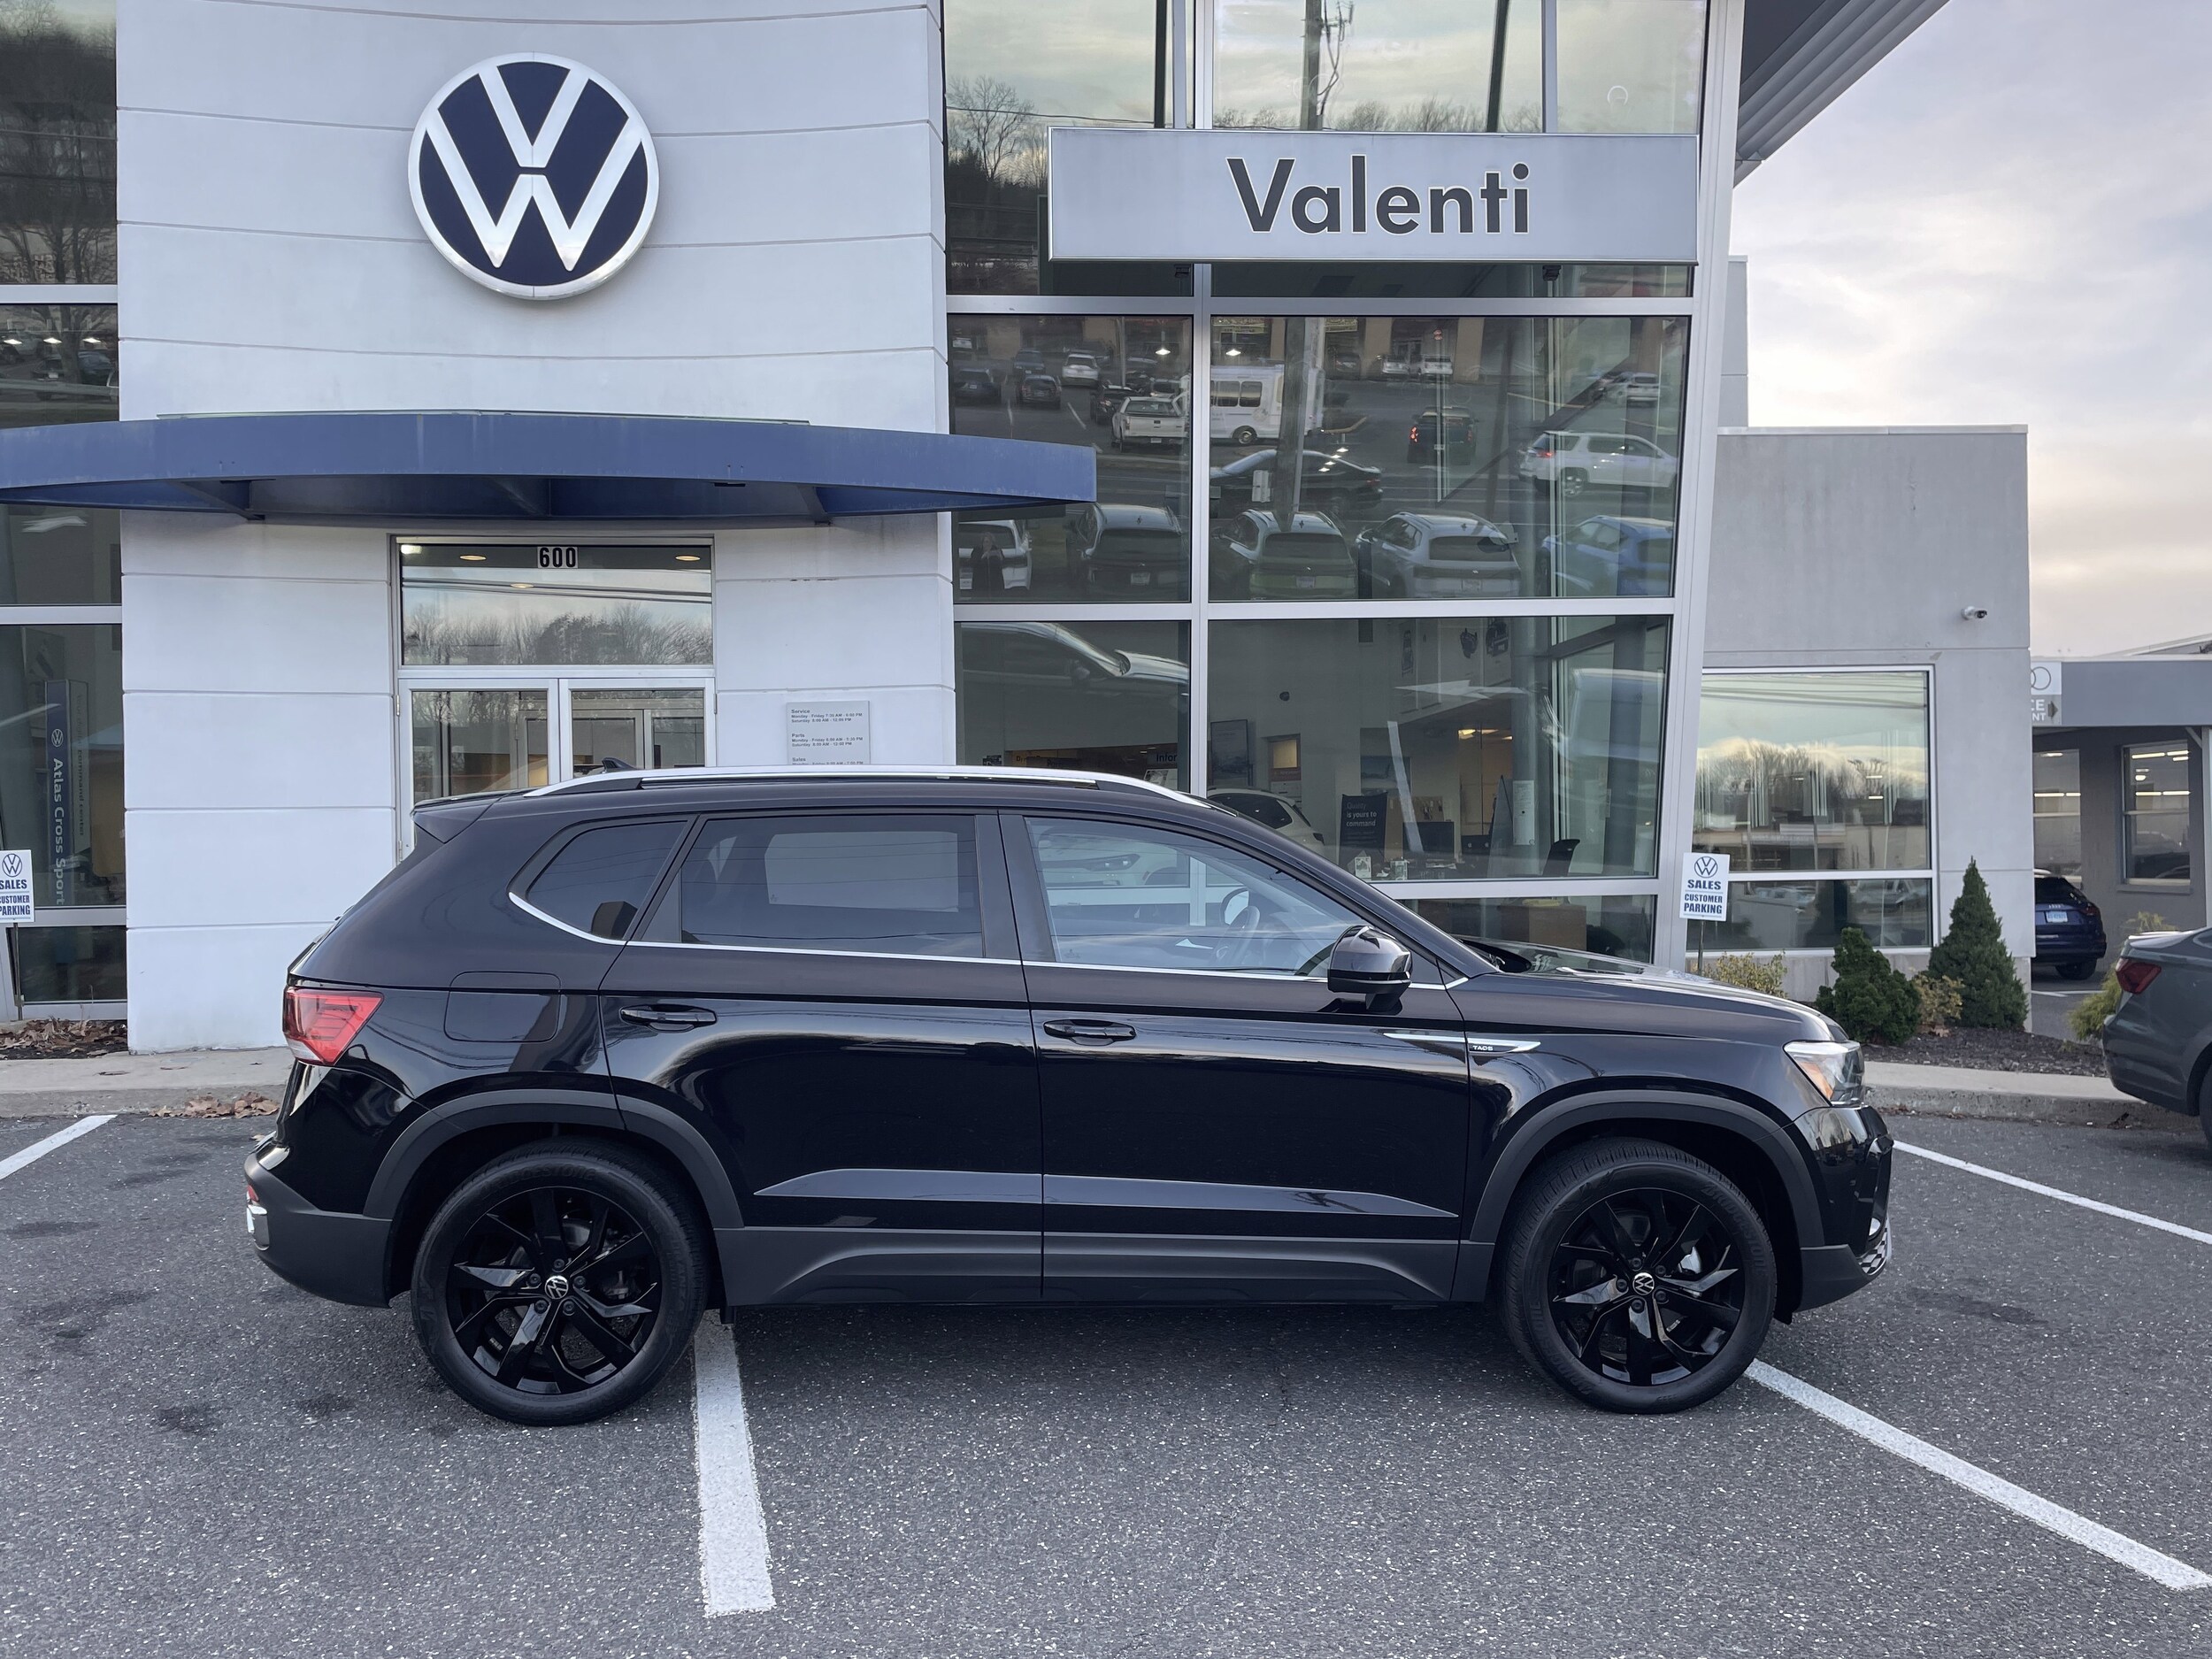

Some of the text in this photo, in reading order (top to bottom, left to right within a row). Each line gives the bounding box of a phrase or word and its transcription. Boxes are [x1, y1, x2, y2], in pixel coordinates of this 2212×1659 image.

[409, 52, 659, 298] VW
[1225, 154, 1531, 235] Valenti
[540, 547, 576, 568] 600
[53, 758, 66, 905] Atlas Cross Sport
[0, 879, 27, 890] SALES
[1687, 879, 1722, 890] SALES
[0, 895, 30, 903] USTOMER
[1684, 893, 1723, 903] CUSTOMER
[1683, 902, 1723, 914] PARKING
